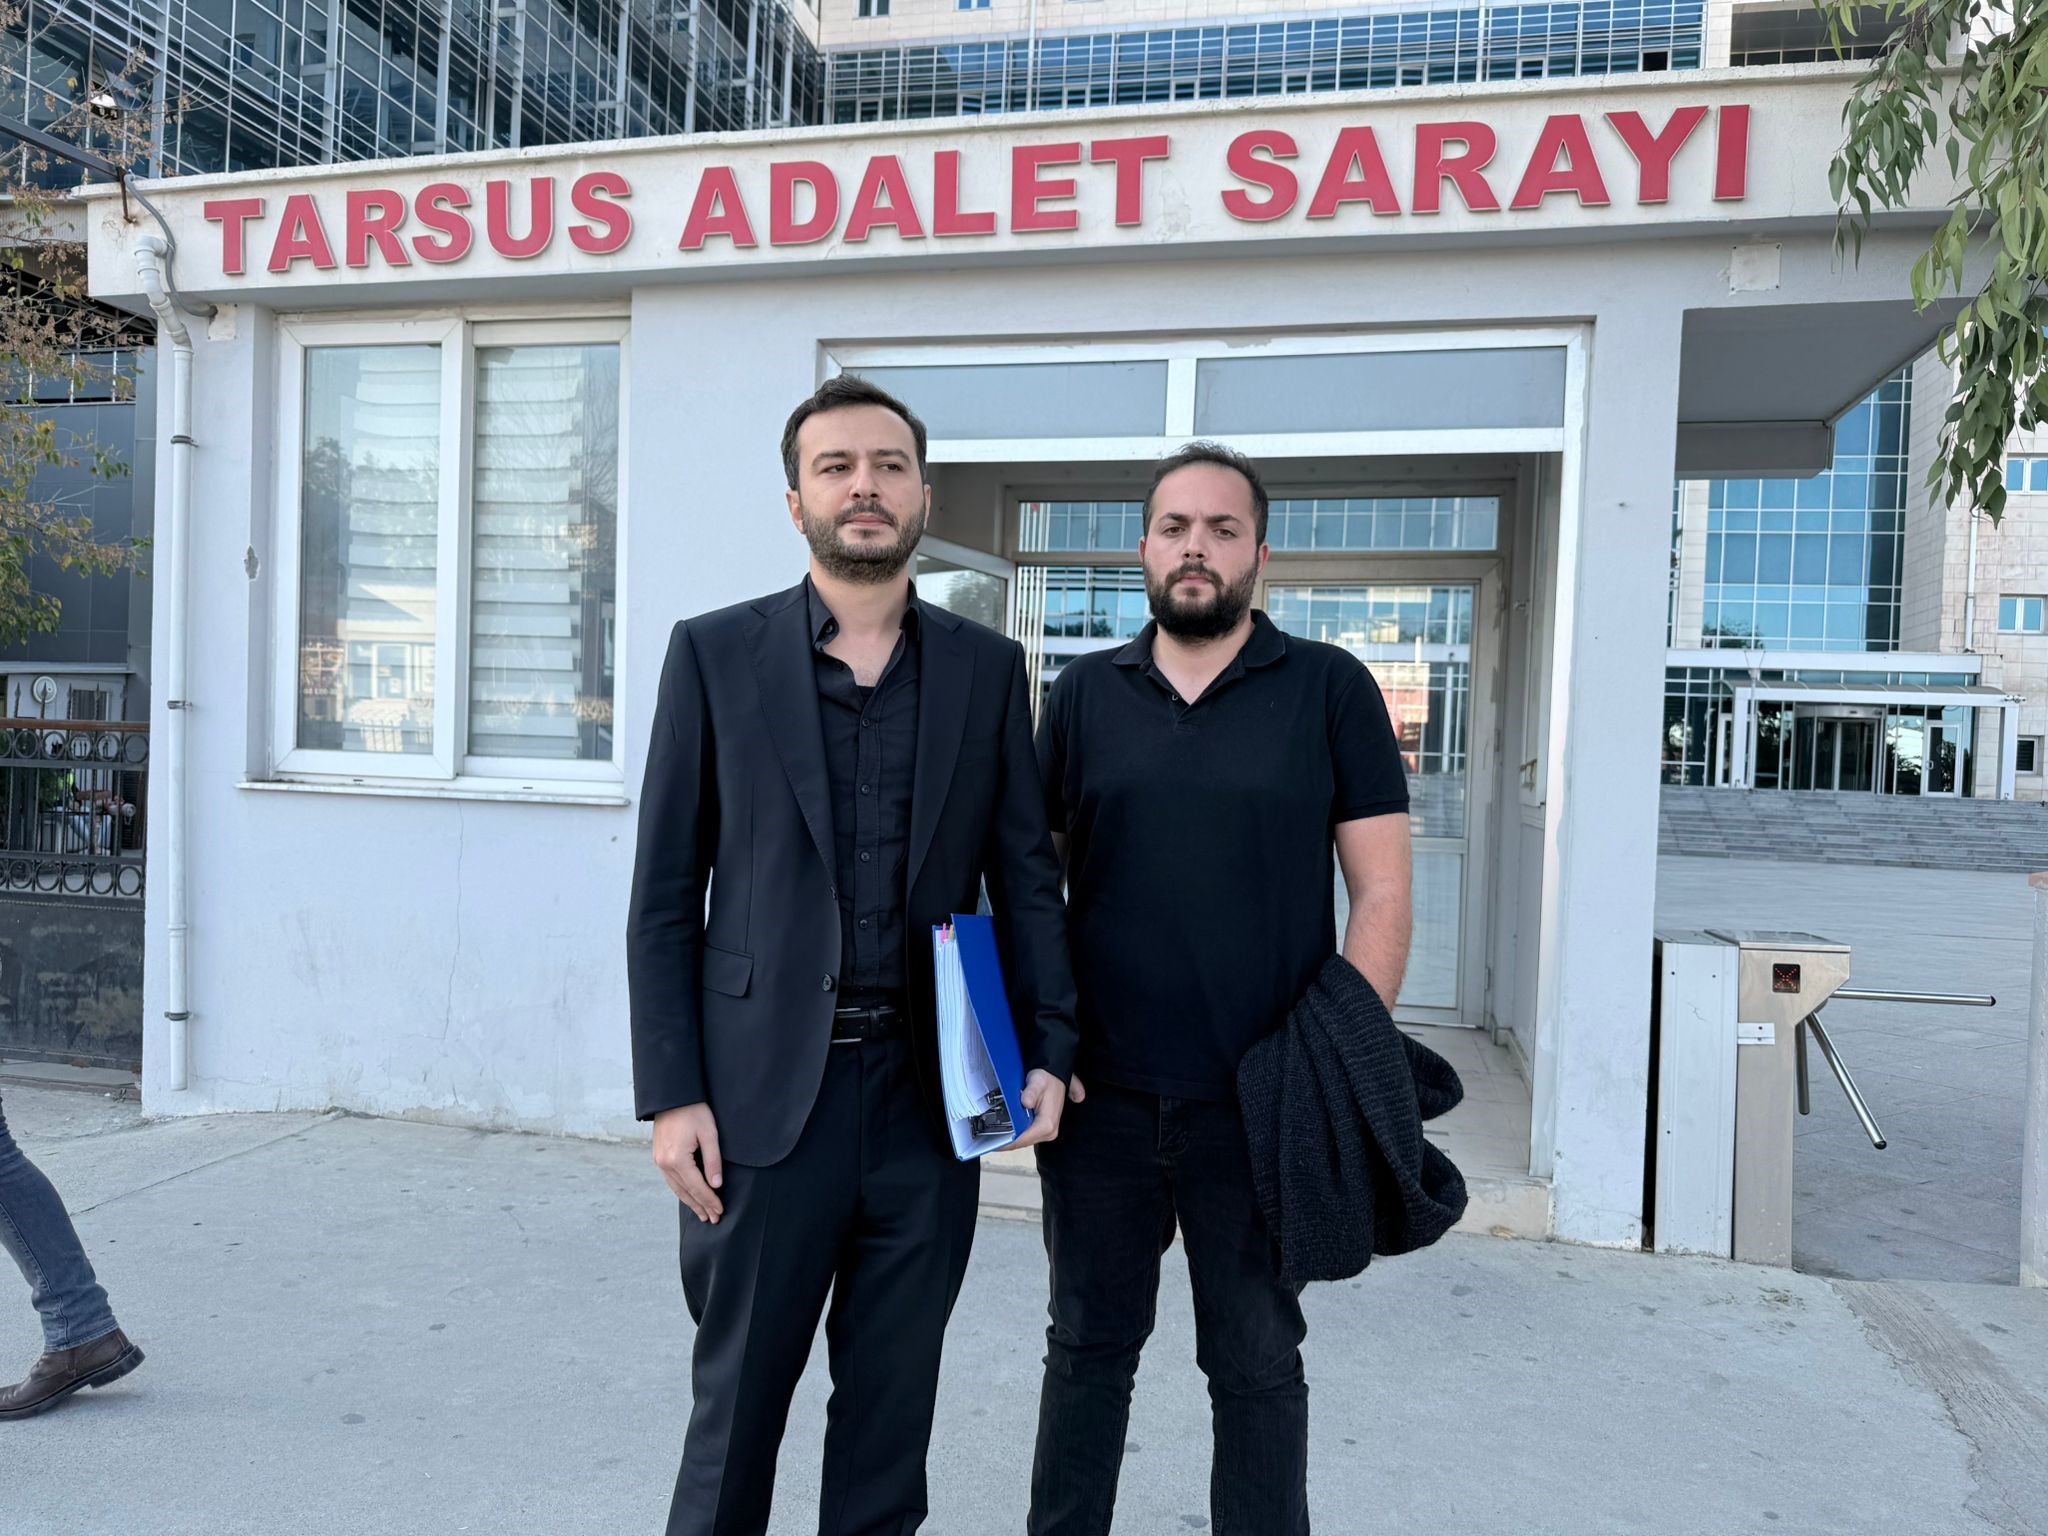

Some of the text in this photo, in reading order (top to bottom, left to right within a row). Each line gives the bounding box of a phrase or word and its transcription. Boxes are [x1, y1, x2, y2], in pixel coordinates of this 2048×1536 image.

[204, 104, 1751, 275] TARSUS ADALET SARAYI
